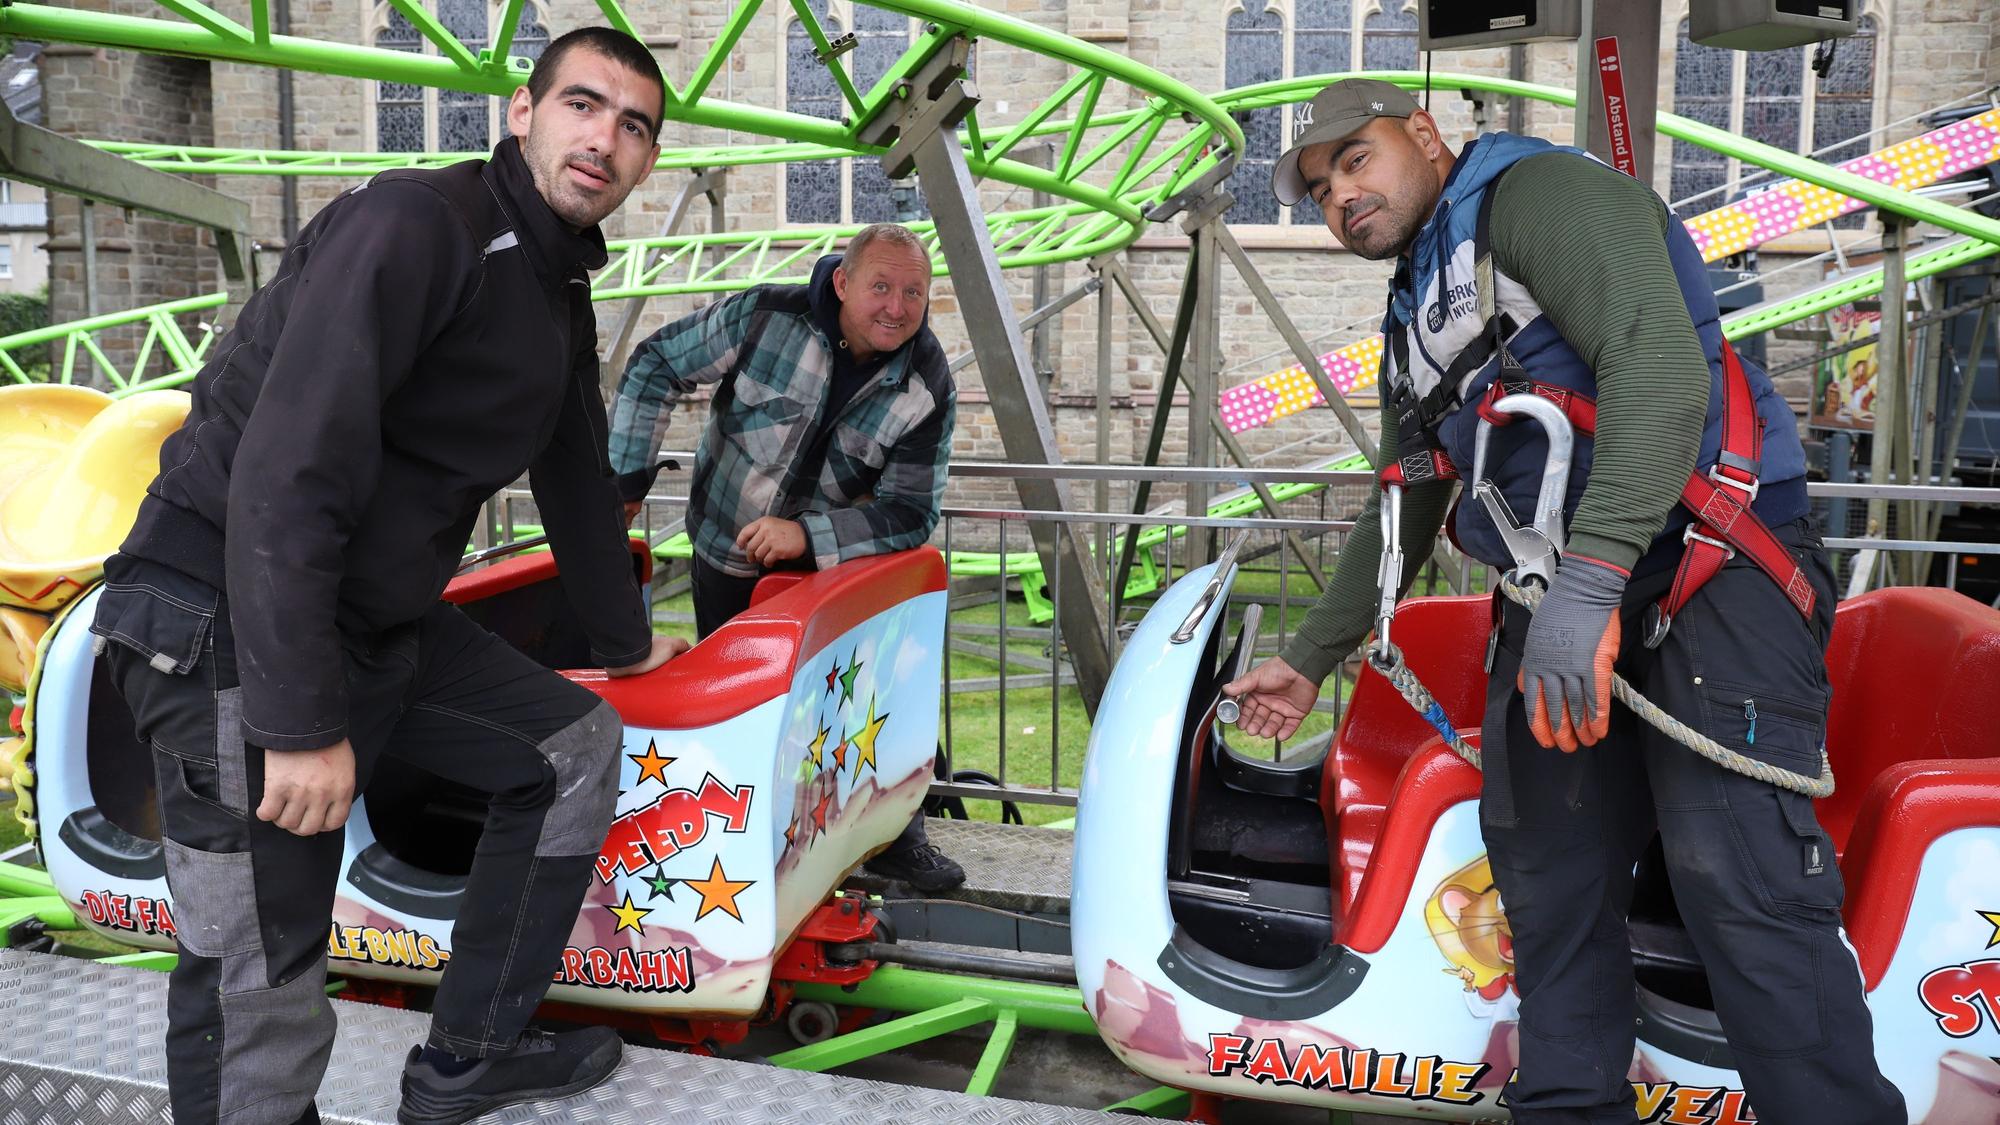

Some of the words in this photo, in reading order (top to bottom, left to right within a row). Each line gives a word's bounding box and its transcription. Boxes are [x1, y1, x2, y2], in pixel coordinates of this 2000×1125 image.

[1609, 95, 1628, 156] Abstand
[1453, 300, 1474, 320] NYC
[590, 771, 755, 887] PEEDY
[81, 889, 138, 932] DIE
[328, 921, 451, 971] LEBNIS-
[1207, 1032, 1492, 1106] FAMILIE
